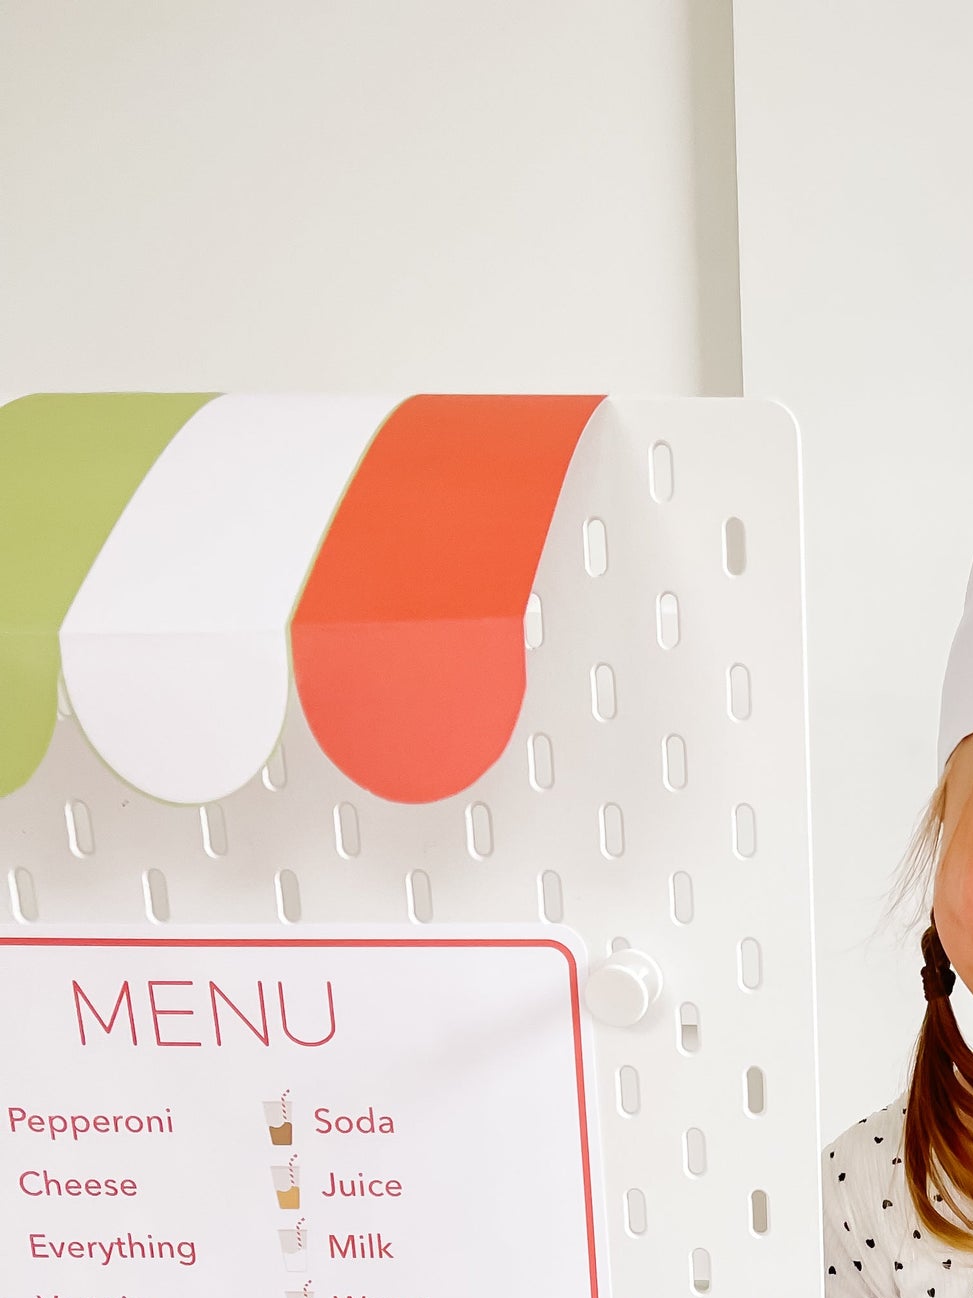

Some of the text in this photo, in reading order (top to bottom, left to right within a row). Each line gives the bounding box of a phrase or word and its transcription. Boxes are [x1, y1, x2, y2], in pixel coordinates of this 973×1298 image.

[72, 980, 337, 1048] MENU
[8, 1107, 173, 1140] Pepperoni
[314, 1108, 395, 1134] Soda
[18, 1170, 137, 1197] Cheese
[321, 1172, 402, 1198] Juice
[29, 1233, 197, 1266] Everything
[328, 1233, 393, 1259] Milk
